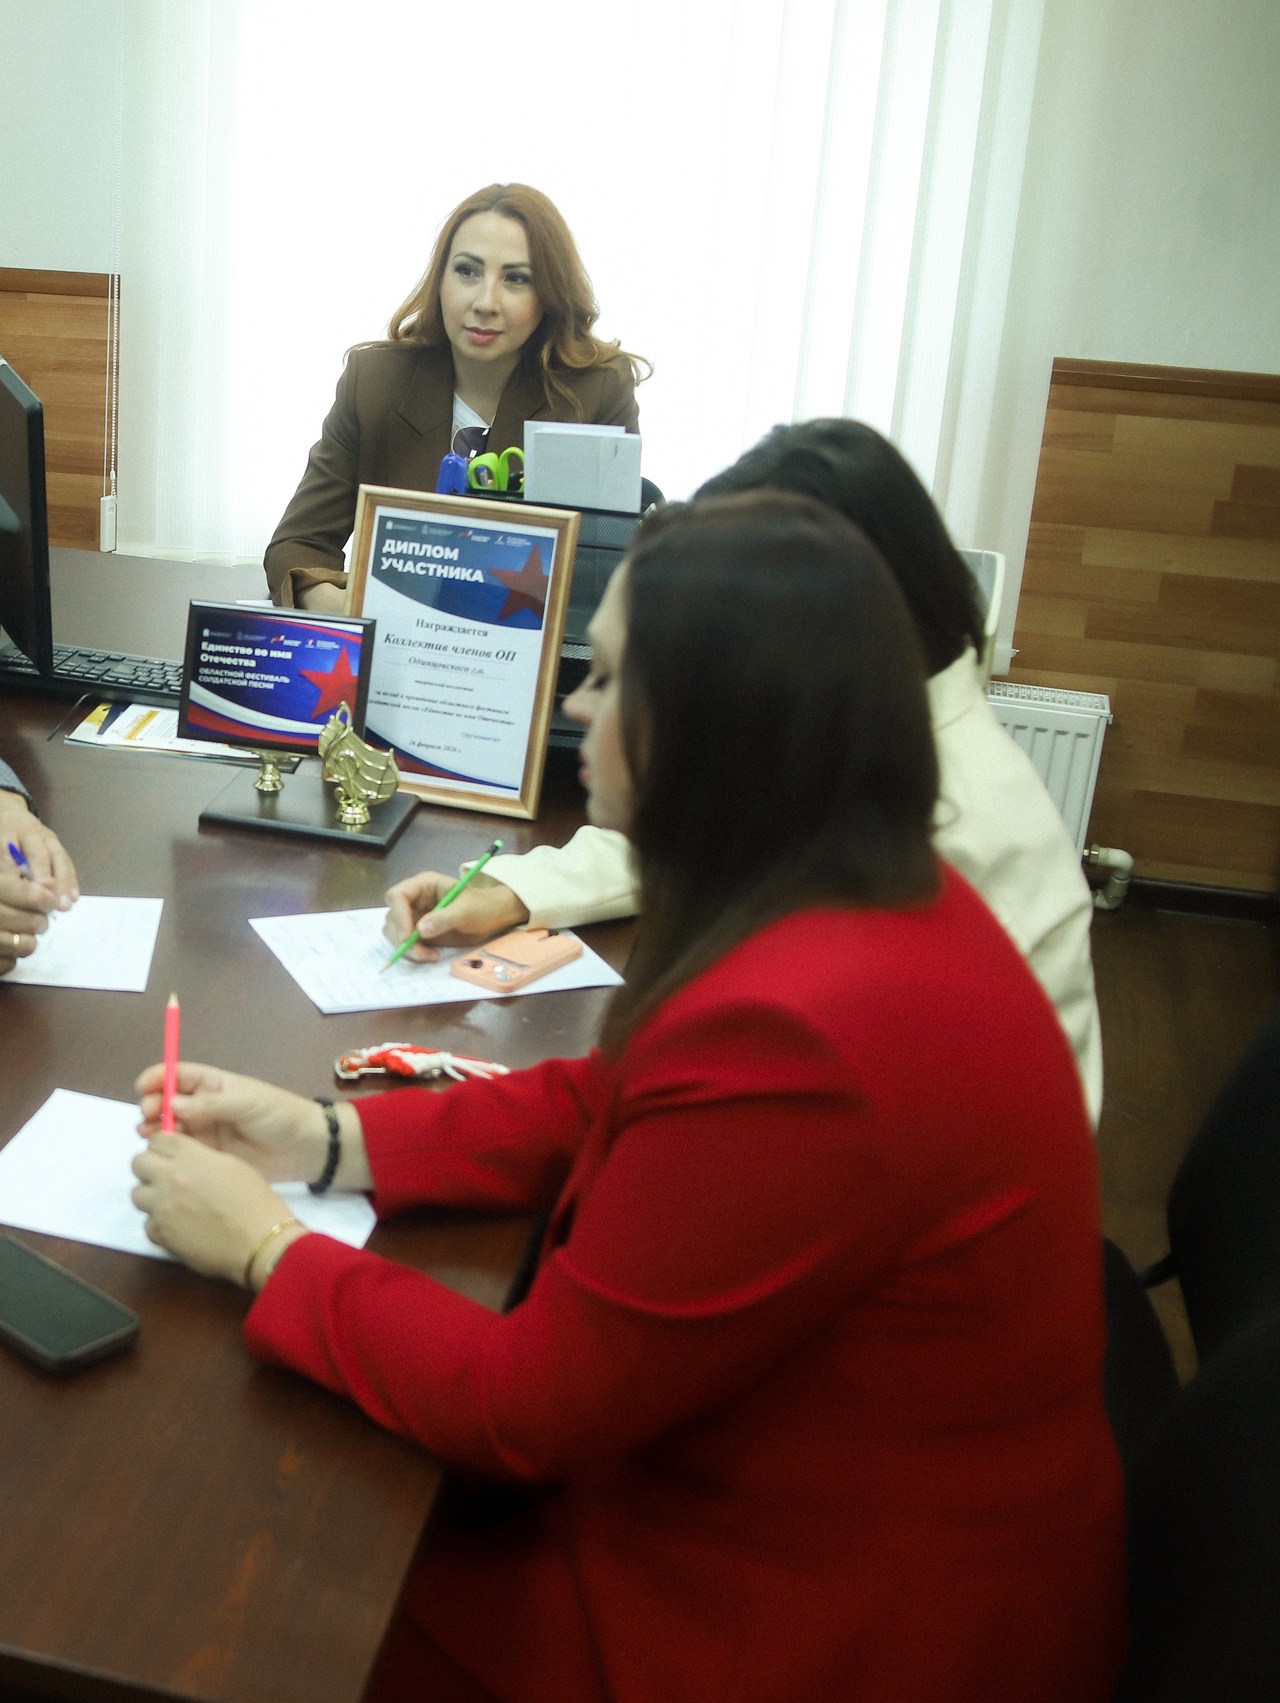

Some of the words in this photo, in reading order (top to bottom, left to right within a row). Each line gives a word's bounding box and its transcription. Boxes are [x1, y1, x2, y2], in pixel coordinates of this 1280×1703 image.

[382, 539, 460, 561] ДИПЛОМ
[380, 557, 484, 583] УЧАСТНИКА
[416, 618, 489, 637] Награждается
[201, 641, 253, 655] Единство
[254, 648, 268, 657] во
[270, 650, 292, 660] имя
[384, 633, 448, 652] Коллектив
[452, 645, 492, 658] членов
[495, 650, 517, 662] ОП
[200, 653, 256, 667] Отечества
[198, 675, 248, 687] СОЛДАТСКОЙ
[248, 679, 274, 690] ПЕСНИ
[199, 667, 244, 679] ОБЛАСТНОЙ
[245, 672, 290, 684] ФЕСТИВАЛЬ
